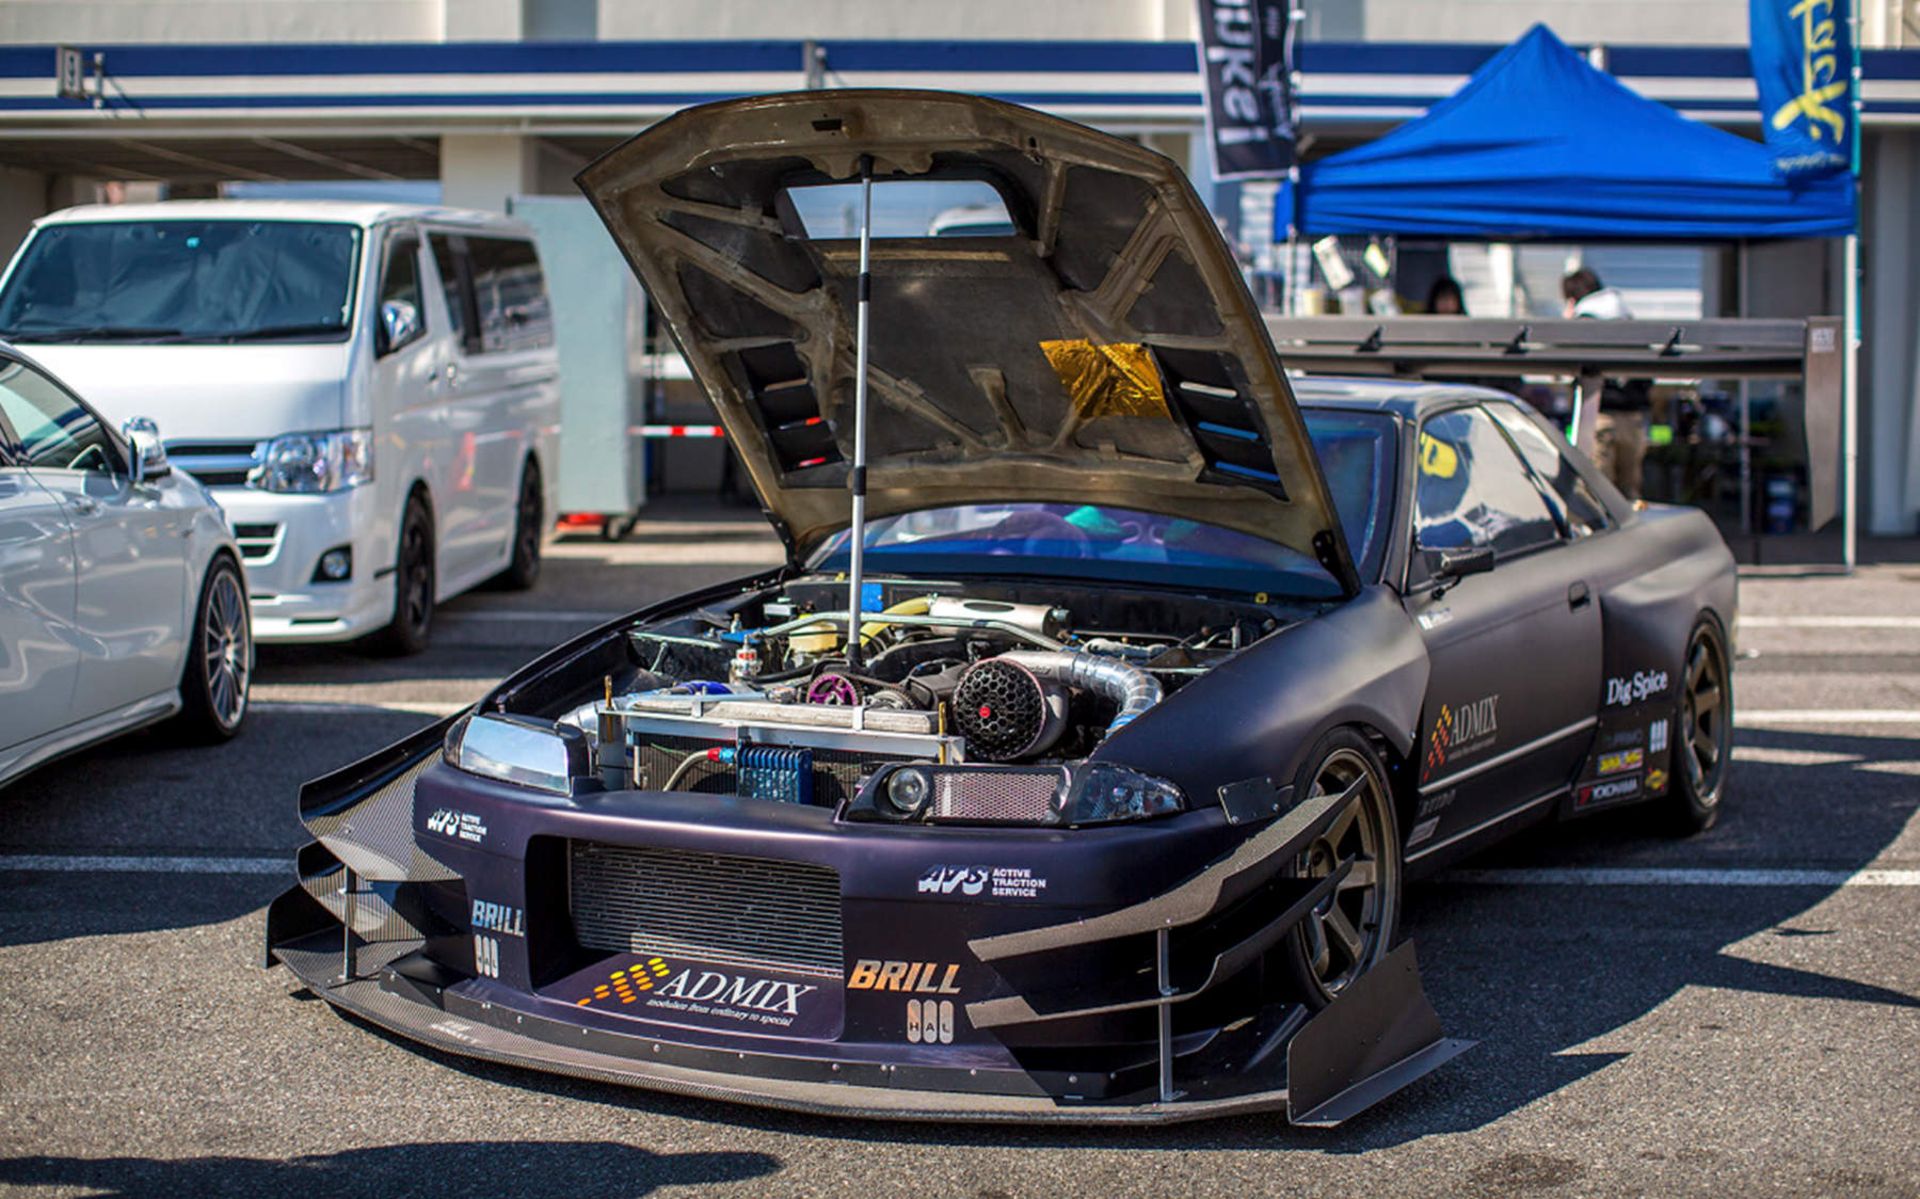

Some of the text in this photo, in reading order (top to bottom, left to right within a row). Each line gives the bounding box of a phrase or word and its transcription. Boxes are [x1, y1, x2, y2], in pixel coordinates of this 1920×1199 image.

[1606, 669, 1668, 706] Dig Spice
[1450, 694, 1499, 747] ADMIX
[991, 868, 1031, 878] ACTIVE
[991, 877, 1046, 888] TRACTION
[991, 887, 1037, 897] SERVICE
[471, 898, 524, 937] BRILL
[653, 968, 818, 1015] ADMIX
[847, 959, 961, 994] BRILL
